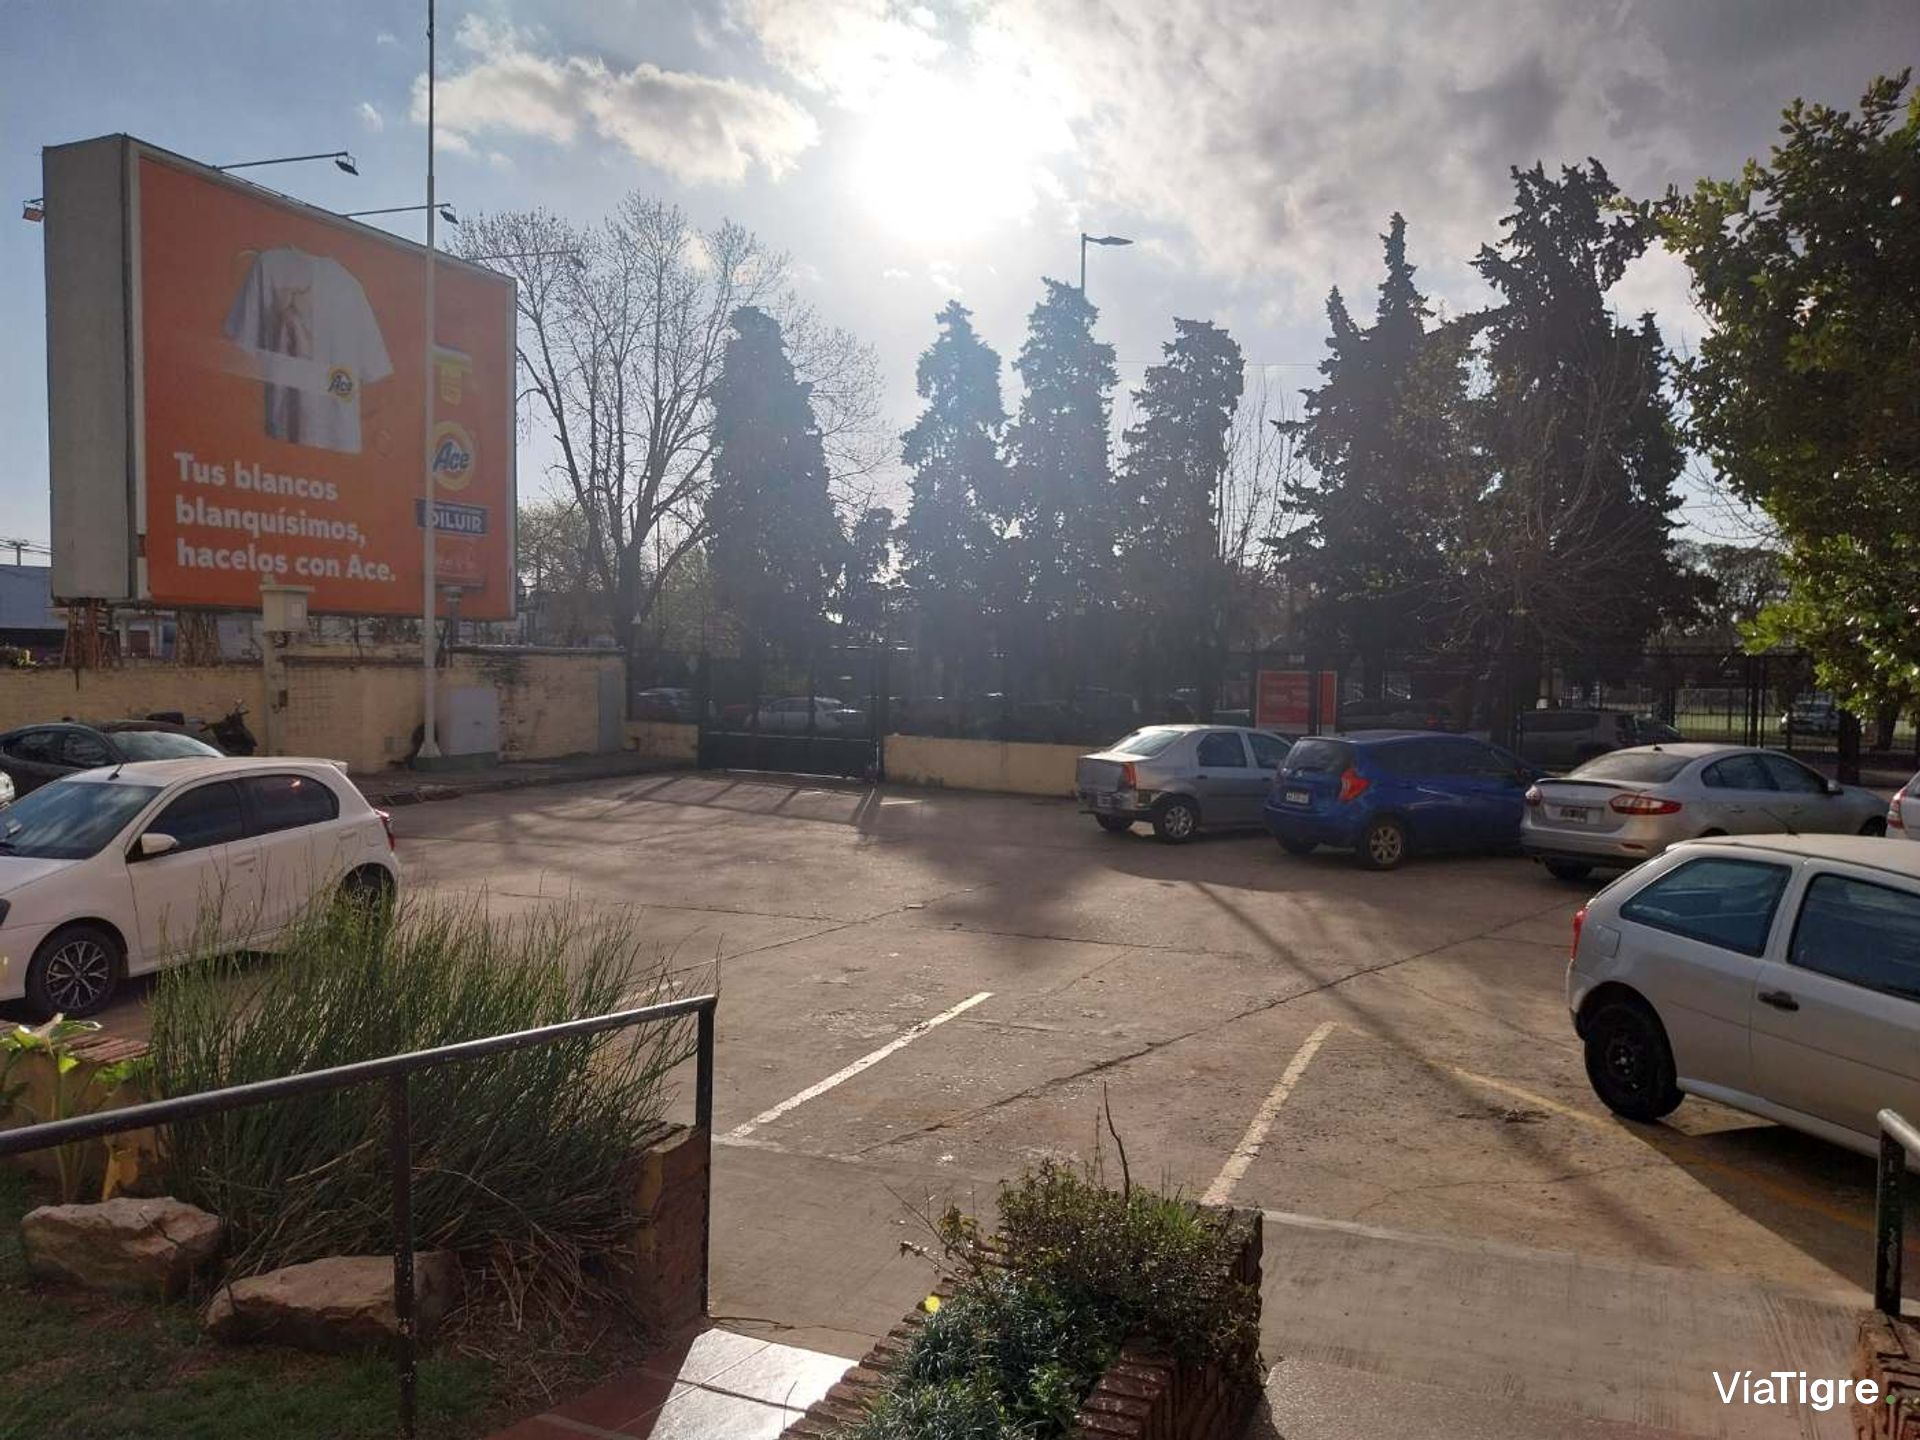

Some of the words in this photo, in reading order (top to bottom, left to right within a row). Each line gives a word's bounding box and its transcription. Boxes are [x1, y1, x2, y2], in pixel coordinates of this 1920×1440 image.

[328, 373, 352, 393] Ace
[174, 451, 226, 486] Tus
[234, 460, 338, 501] blancos
[431, 437, 471, 472] Ace
[175, 494, 366, 548] blanquísimos,
[176, 537, 288, 574] hacelos
[295, 555, 339, 578] con
[346, 554, 396, 582] Ace.
